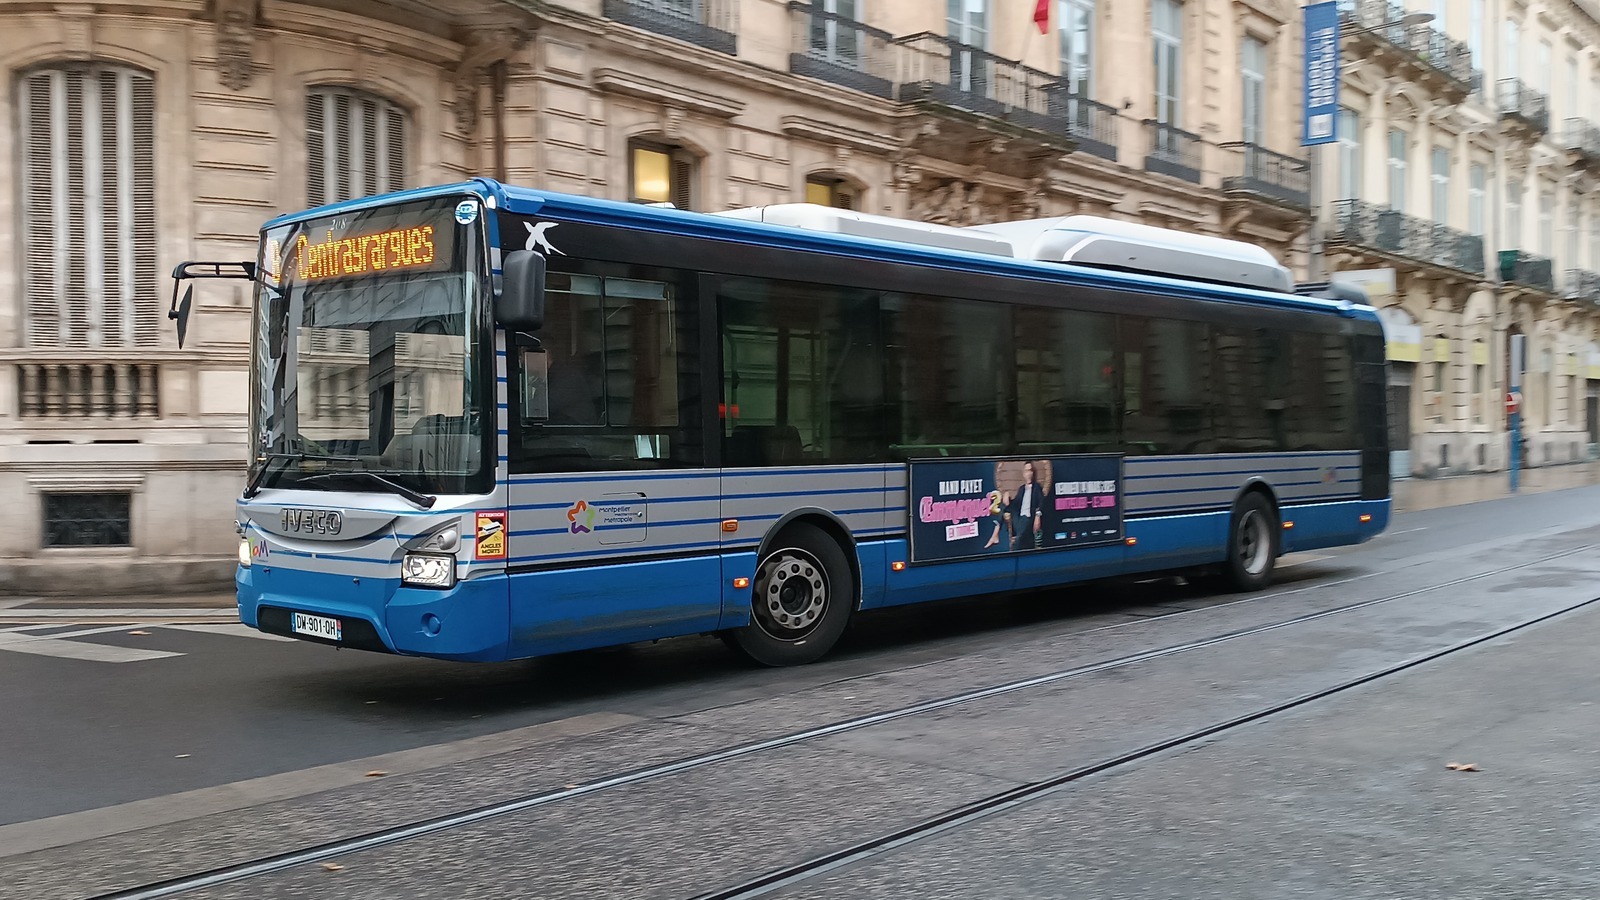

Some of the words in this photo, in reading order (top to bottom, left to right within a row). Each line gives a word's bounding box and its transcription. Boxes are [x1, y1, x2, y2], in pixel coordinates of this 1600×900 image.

[330, 218, 347, 231] 208
[297, 226, 434, 280] Centrayrargues
[281, 508, 342, 535] IVECO
[296, 614, 337, 636] DW-901-QH
